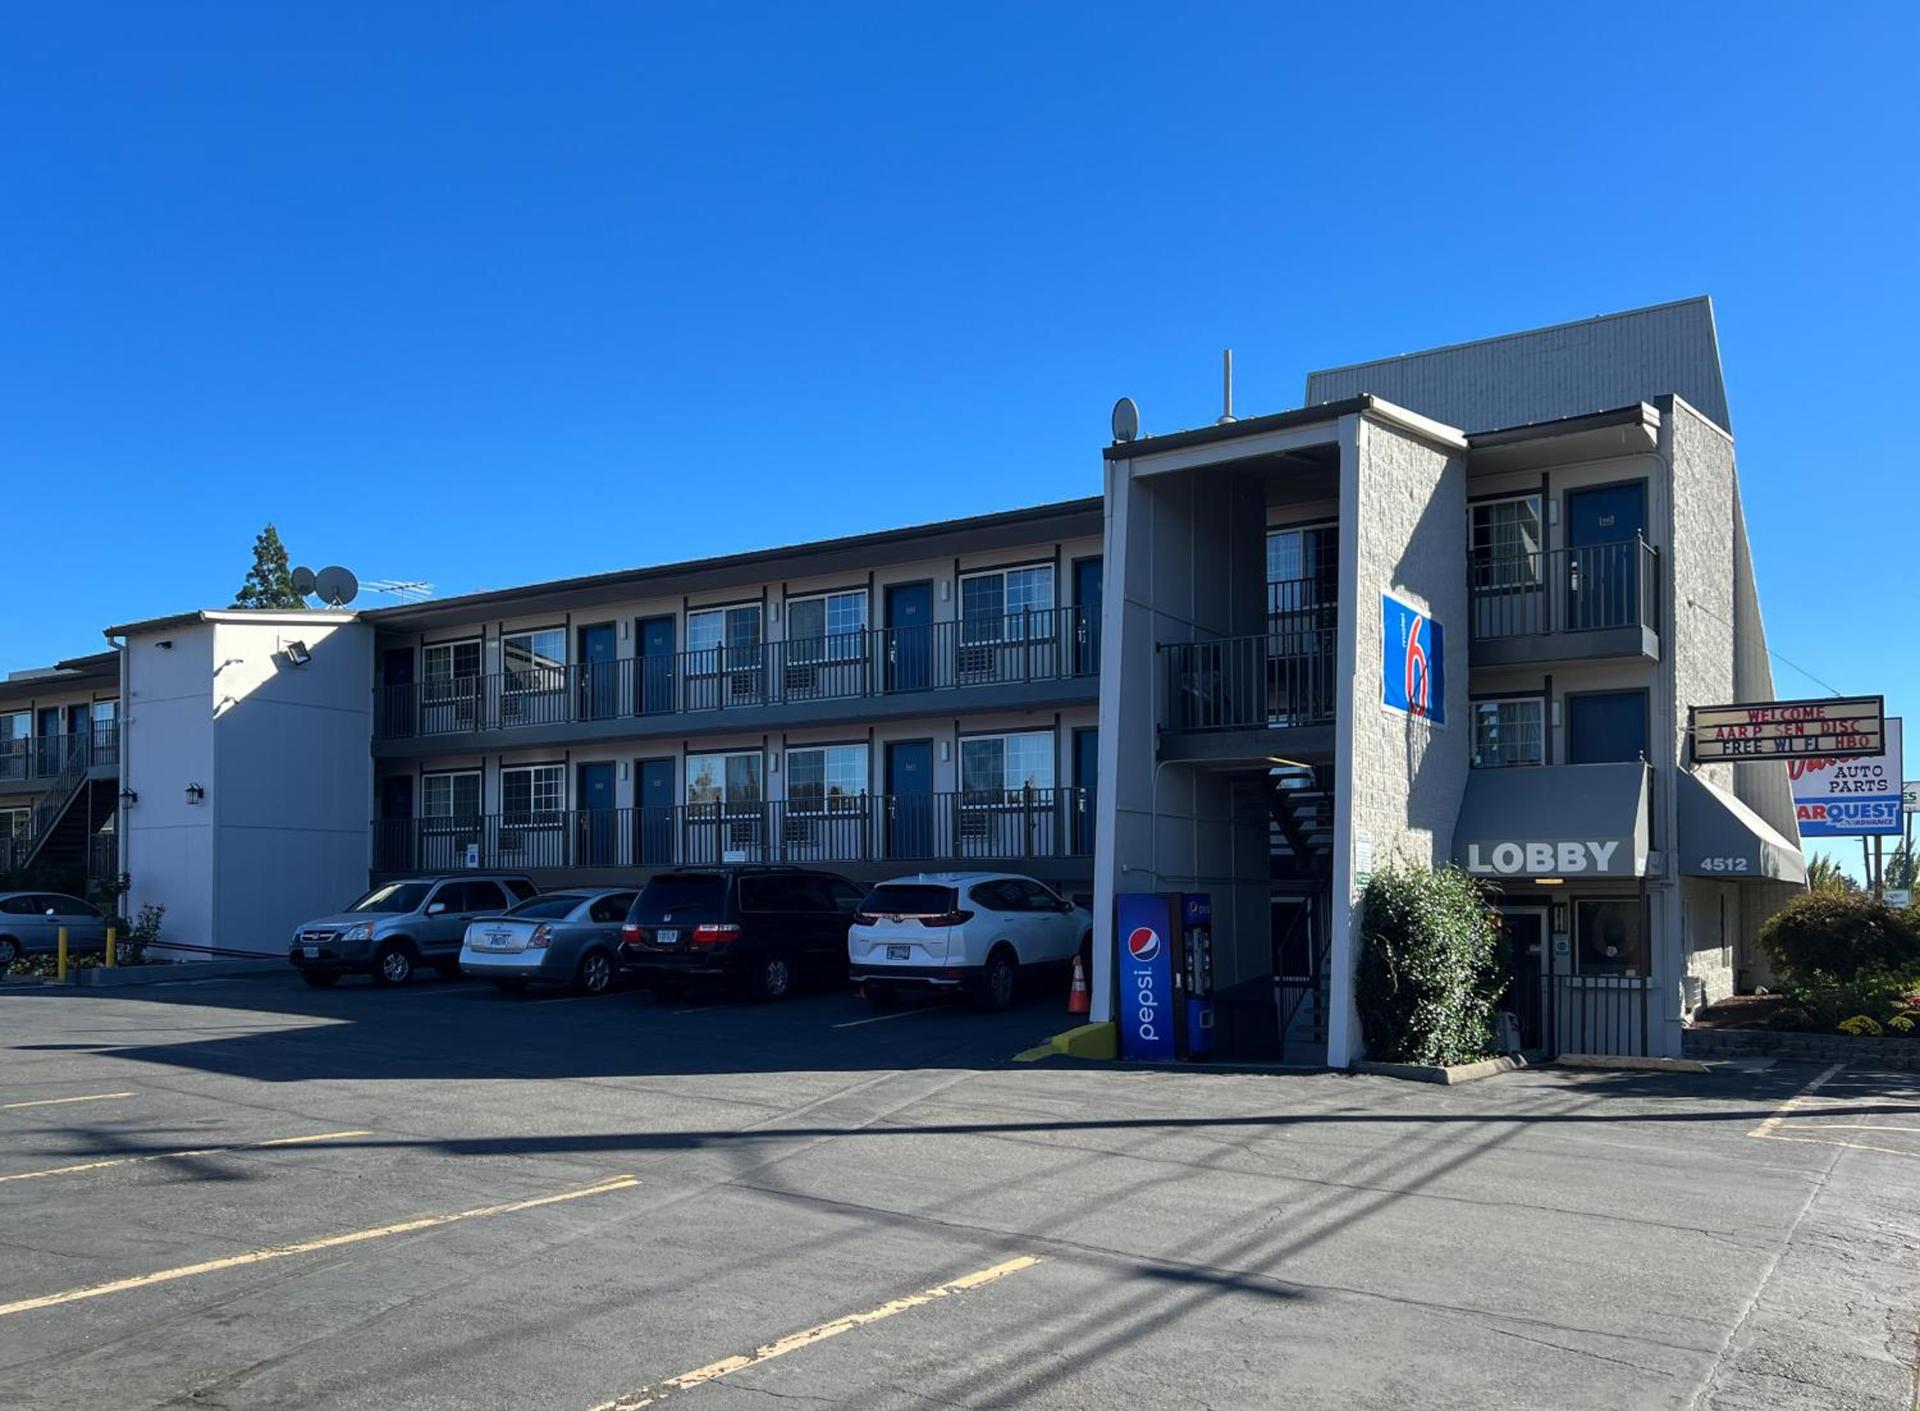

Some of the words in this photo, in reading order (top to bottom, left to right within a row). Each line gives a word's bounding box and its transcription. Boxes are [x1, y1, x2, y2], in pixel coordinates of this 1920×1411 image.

[1405, 615, 1428, 716] 6
[1747, 706, 1825, 723] WELCOME
[1716, 725, 1762, 738] AARP
[1775, 722, 1804, 736] SEN
[1821, 720, 1860, 734] DISC
[1722, 740, 1762, 754] FREE
[1835, 735, 1869, 749] HBO
[1834, 765, 1883, 779] AUTO
[1829, 780, 1888, 793] PARTS
[1797, 803, 1897, 823] ARQUEST
[1468, 841, 1619, 874] LOBBY
[1700, 857, 1748, 871] 4512
[1133, 970, 1159, 1040] pepsi
